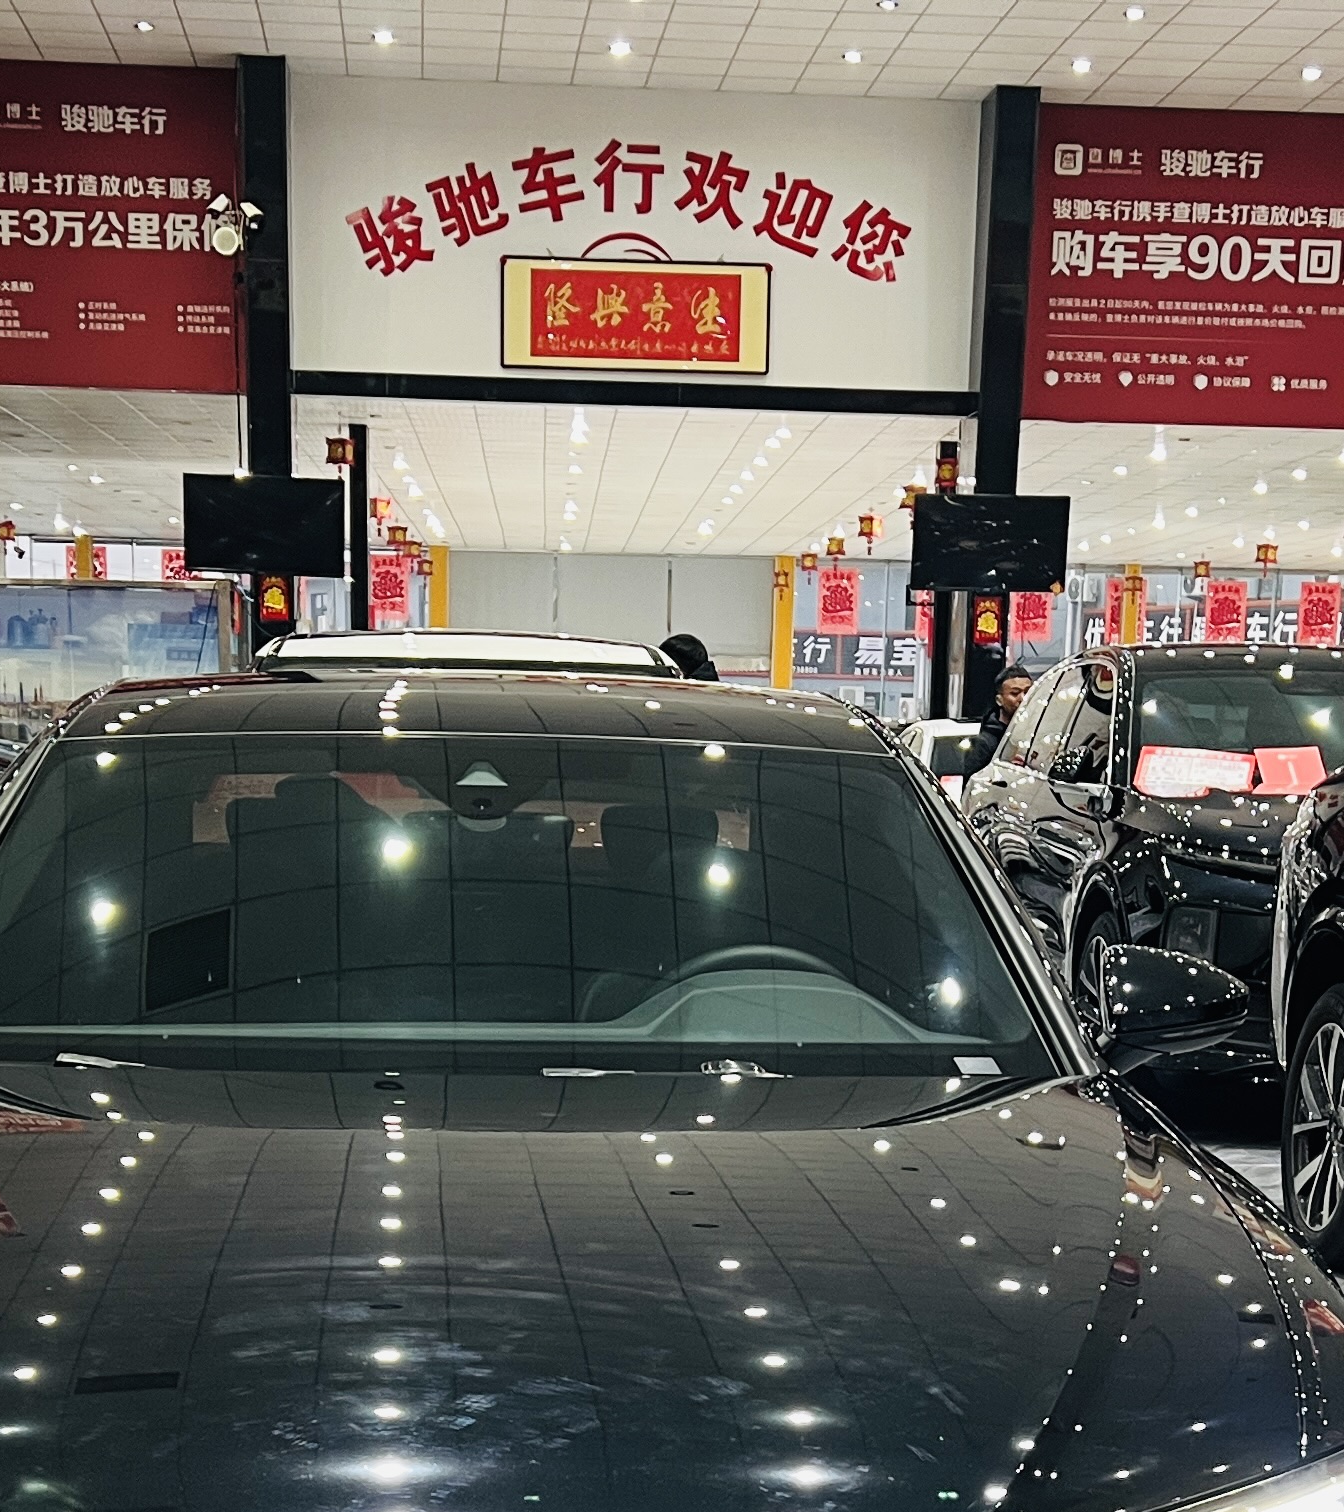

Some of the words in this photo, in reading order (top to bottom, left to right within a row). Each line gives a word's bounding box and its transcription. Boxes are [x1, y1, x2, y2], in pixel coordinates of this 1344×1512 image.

[61, 104, 167, 135] 骏驰车行
[1160, 149, 1264, 179] 骏驰车行
[346, 138, 912, 283] 骏驰车行欢迎您
